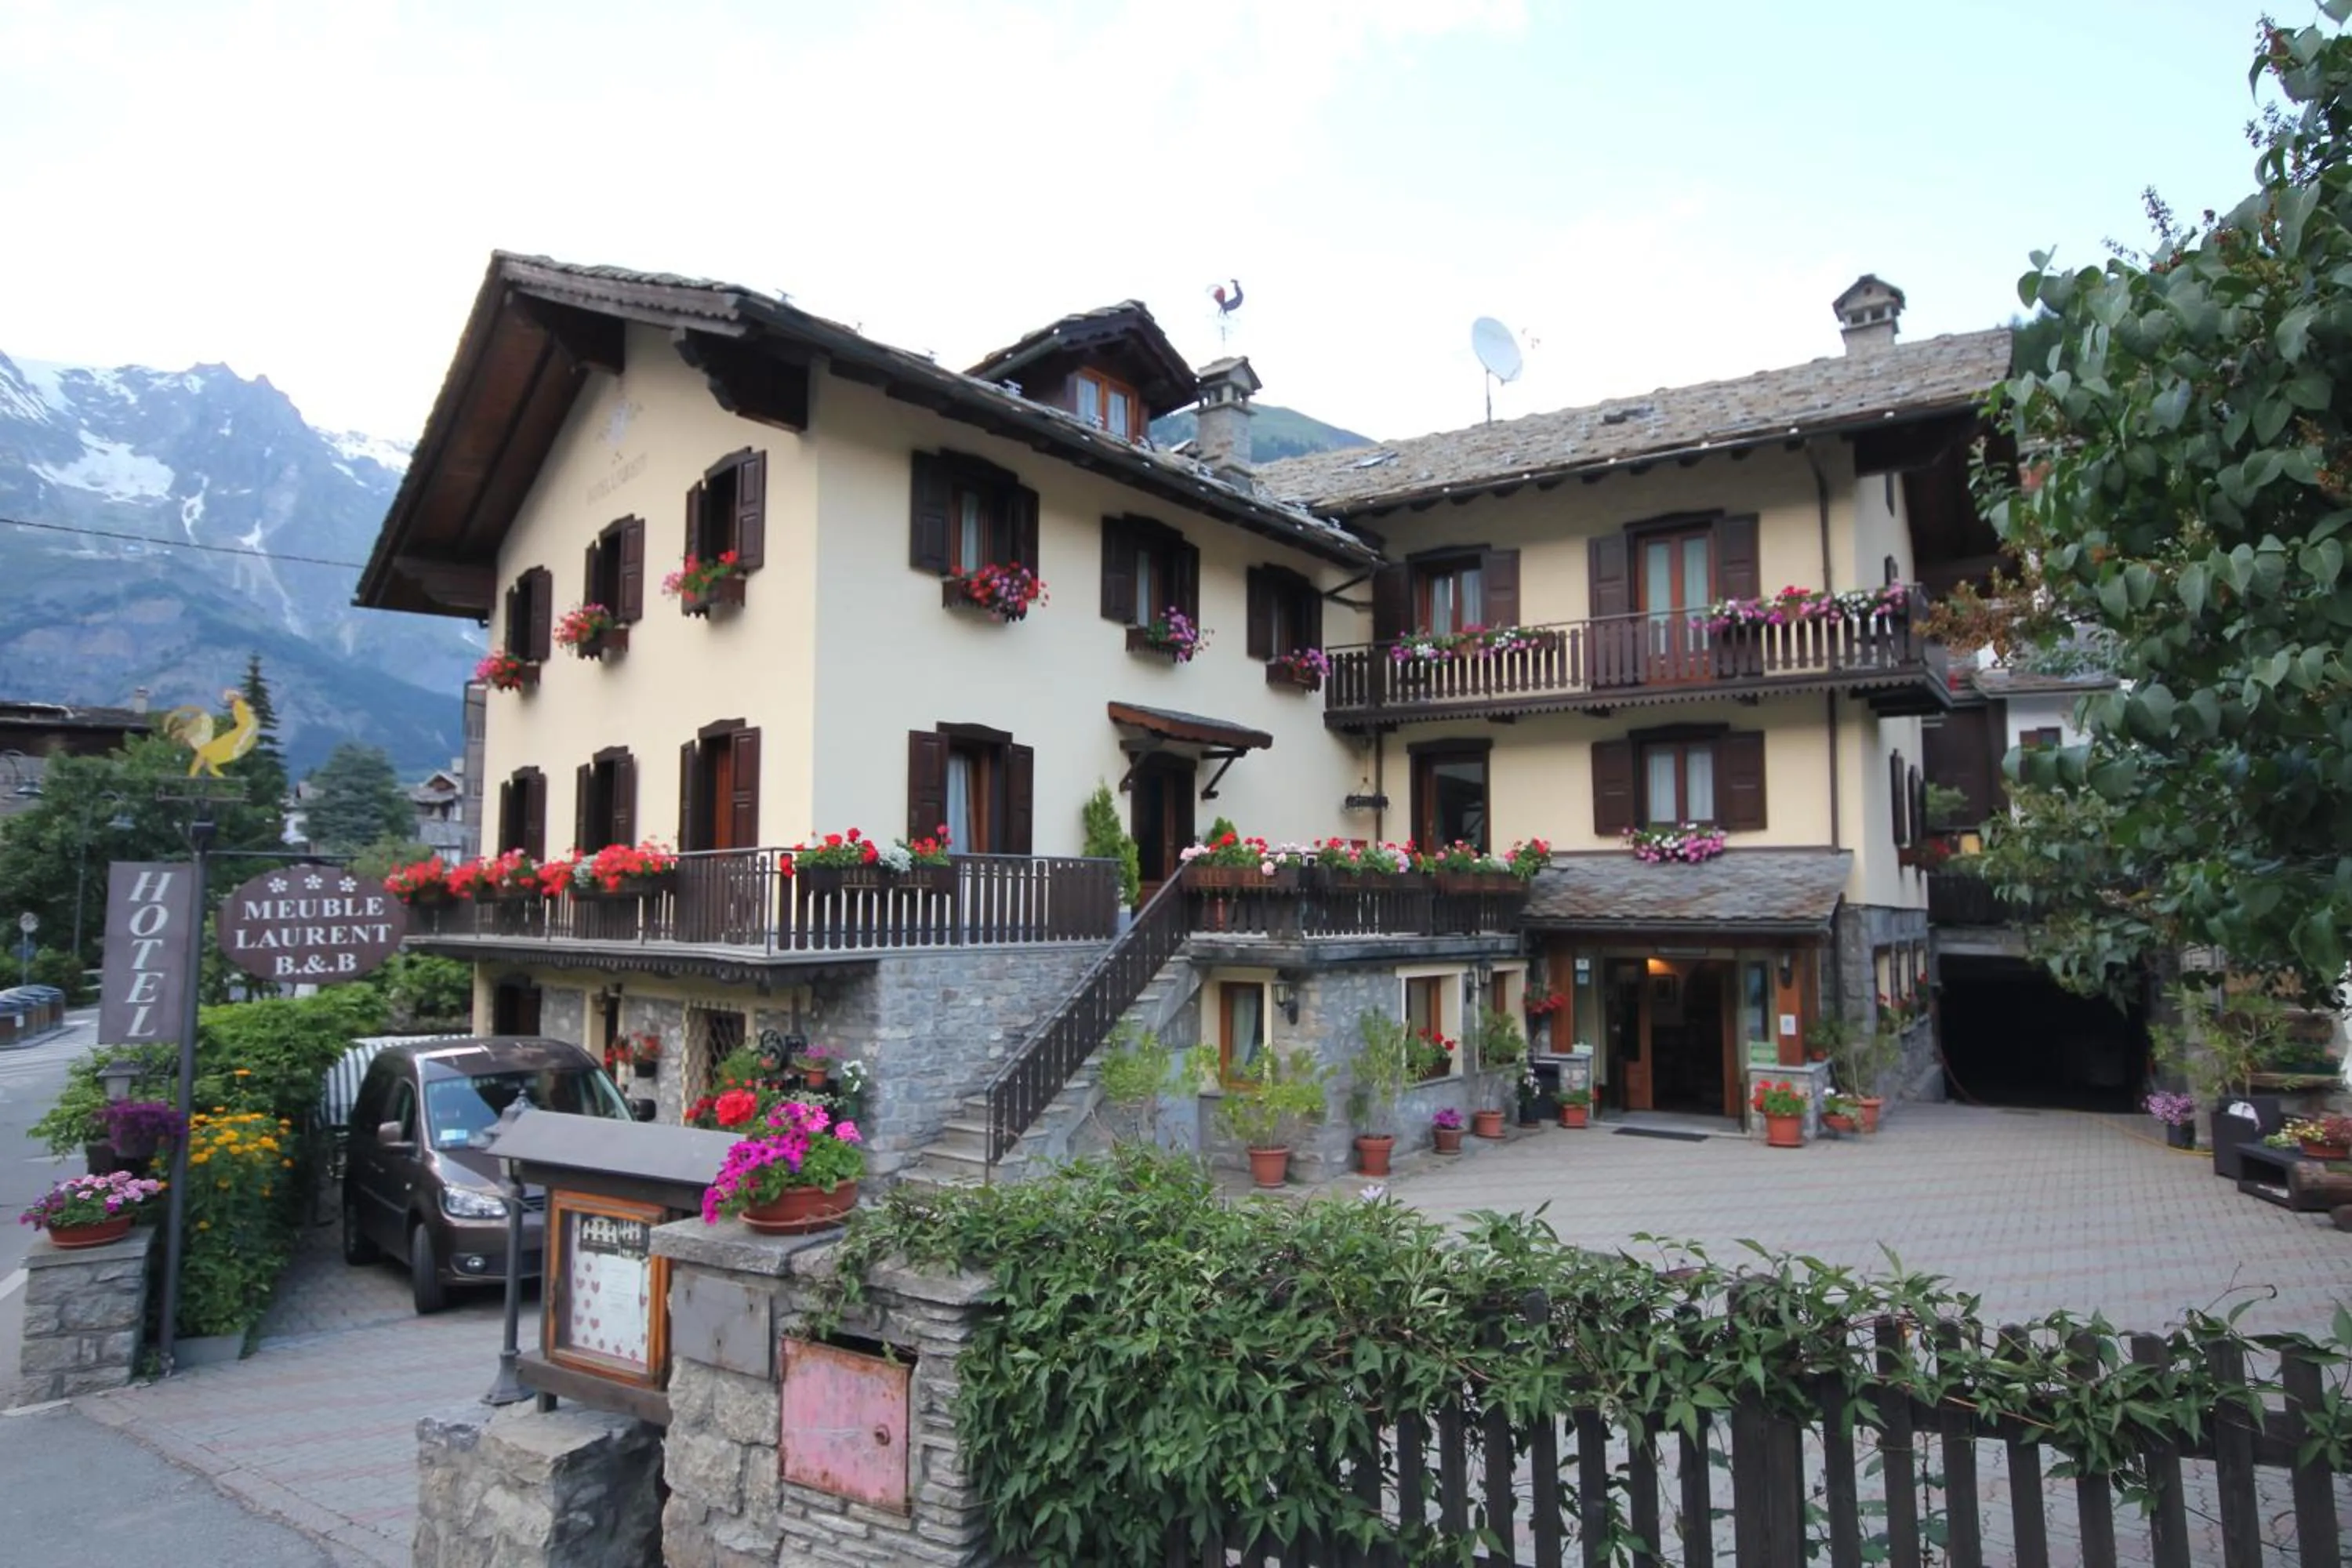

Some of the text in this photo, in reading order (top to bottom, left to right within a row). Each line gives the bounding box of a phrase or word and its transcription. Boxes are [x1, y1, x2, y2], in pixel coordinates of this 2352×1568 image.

[244, 896, 385, 920] MEUBLE
[236, 924, 392, 949] LAURENT
[125, 872, 172, 1037] HOTEL
